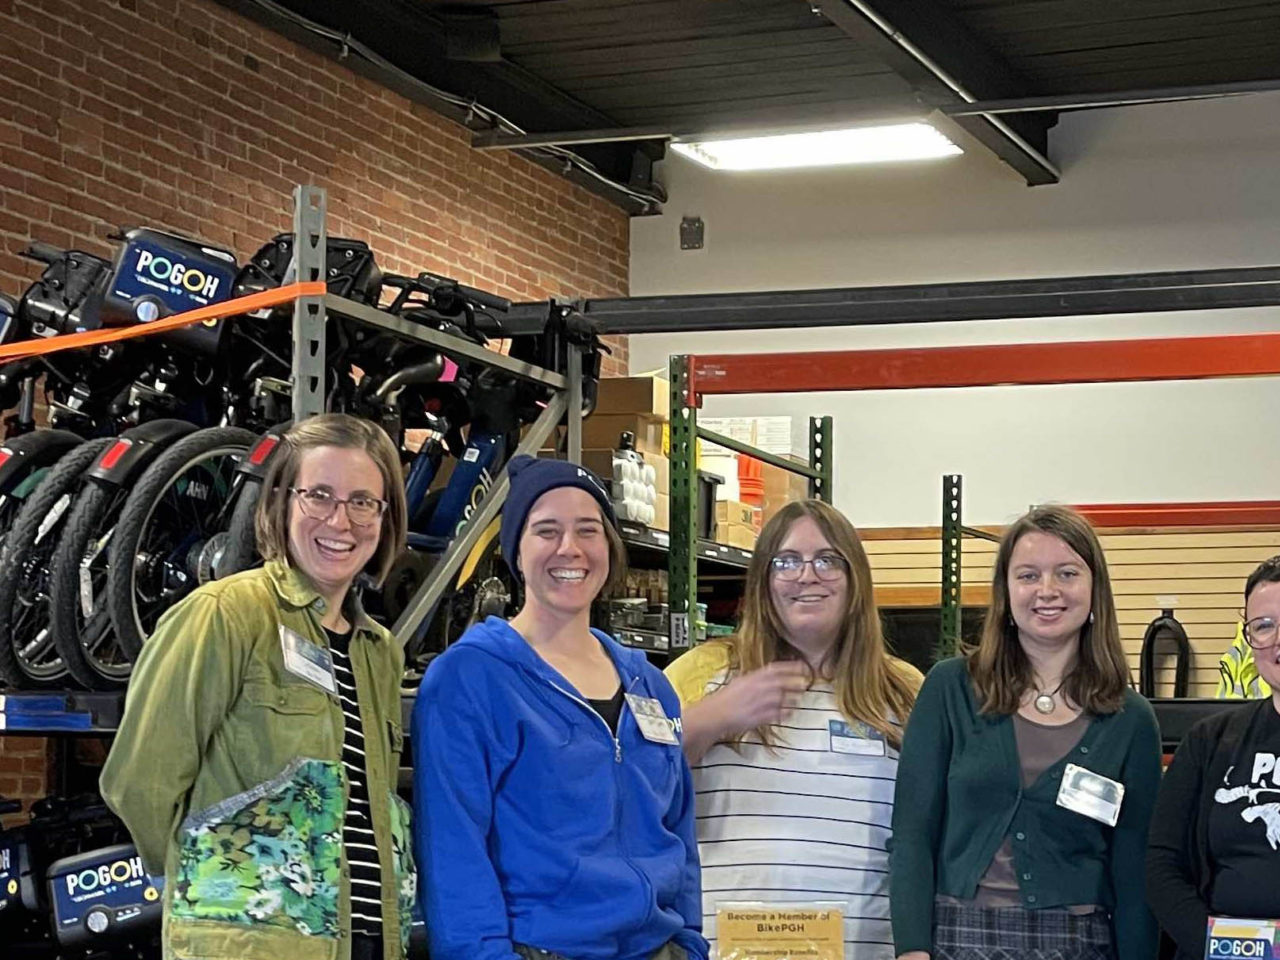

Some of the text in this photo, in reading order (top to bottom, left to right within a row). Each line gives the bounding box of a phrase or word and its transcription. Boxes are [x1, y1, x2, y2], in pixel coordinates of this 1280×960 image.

[136, 250, 219, 299] POGOH
[66, 856, 144, 896] POGOH
[727, 912, 767, 921] Become
[778, 912, 818, 921] Member
[757, 923, 805, 933] BikePGH
[1209, 939, 1265, 957] POGOH
